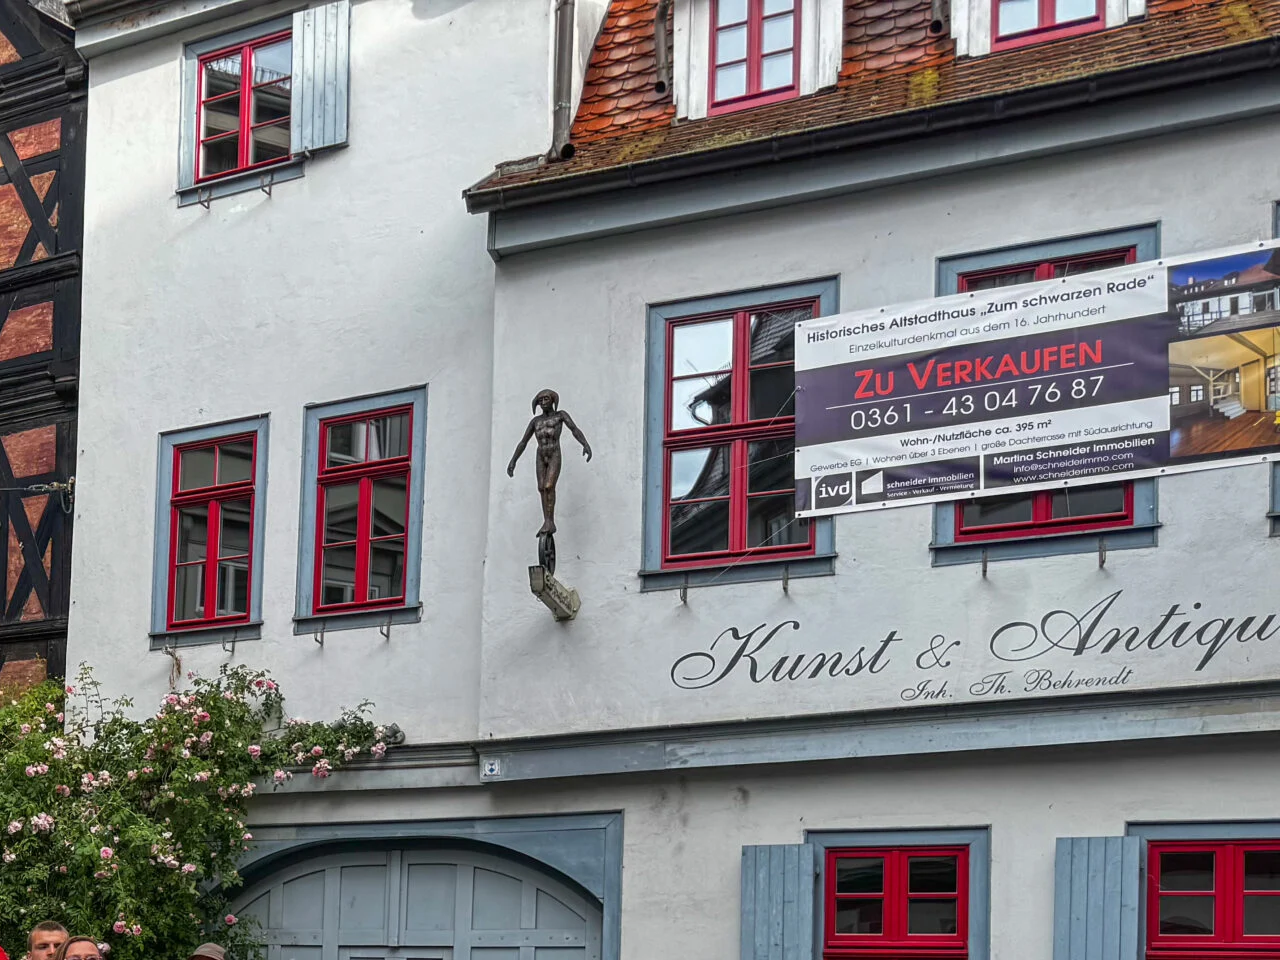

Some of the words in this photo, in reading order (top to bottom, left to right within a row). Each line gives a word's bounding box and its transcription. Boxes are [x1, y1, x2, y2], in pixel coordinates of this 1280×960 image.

[807, 321, 885, 343] Historisches
[888, 307, 976, 329] Altstadthaus
[1022, 285, 1101, 308] schwarzen
[849, 329, 957, 354] Einzelkulturdenkmal
[959, 325, 980, 336] aus
[983, 321, 1010, 333] dem
[1014, 317, 1030, 327] 16.
[1033, 304, 1107, 325] Jahrhundert
[851, 403, 911, 430] 0361
[942, 394, 974, 416] 43
[984, 388, 1018, 412] 04
[1028, 380, 1061, 406] 76
[1071, 376, 1104, 399] 87
[810, 460, 848, 473] Gewerbe
[850, 458, 862, 467] EG
[872, 453, 907, 465] Wohnen
[909, 450, 928, 461] über
[930, 448, 936, 456] 3
[937, 445, 970, 456] Ebenen
[981, 440, 1006, 451] große
[1008, 432, 1065, 446] Dachterrasse
[1068, 429, 1081, 438] mit
[1083, 420, 1153, 437] Südausrichtung
[900, 425, 991, 448] Wohn-/Nutzfläche
[995, 426, 1012, 435] ca.
[1015, 422, 1034, 433] 395
[993, 452, 1033, 466] Martina
[1036, 445, 1091, 460] Schneider
[1093, 436, 1155, 452] Immobilien
[819, 480, 850, 498] ivd
[886, 477, 926, 489] schneider
[928, 472, 974, 484] immobilien
[1013, 462, 1134, 484] www.schneiderimmo.com
[887, 490, 907, 498] Service
[912, 487, 935, 495] Verkauf
[939, 483, 974, 492] Vermietung
[670, 620, 903, 690] Kunst
[916, 634, 961, 670] &
[900, 679, 953, 701] Inh.
[969, 670, 1012, 696] Th.
[1023, 665, 1134, 692] Behrendt
